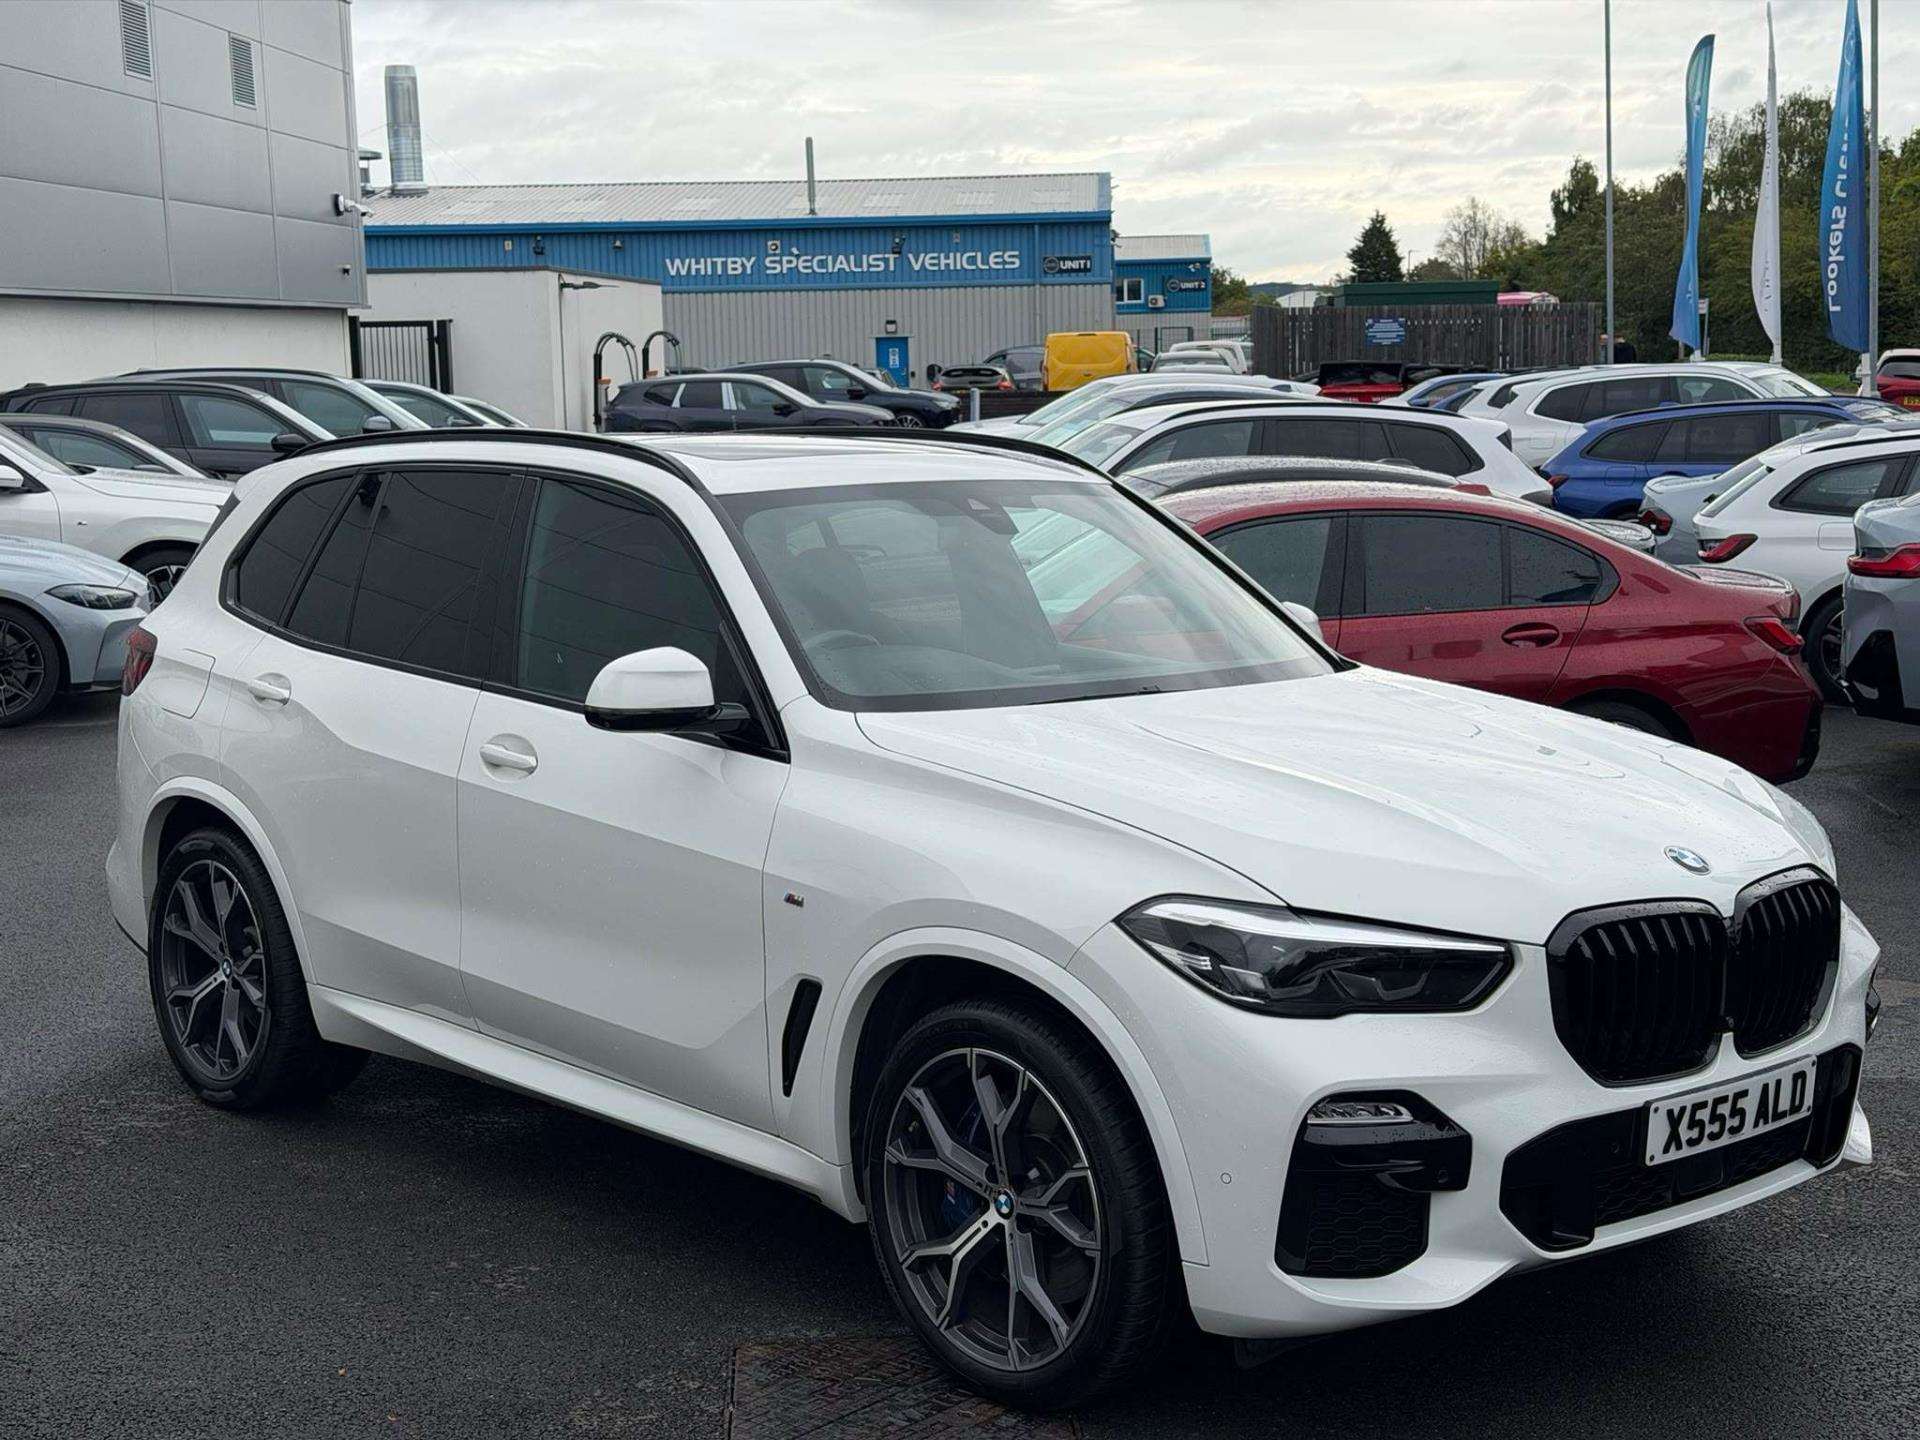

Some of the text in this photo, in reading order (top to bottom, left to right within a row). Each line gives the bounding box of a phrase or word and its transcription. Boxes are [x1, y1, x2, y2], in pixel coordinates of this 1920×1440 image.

[665, 251, 1021, 276] WHITBY SPECIALIST VEHICLES
[1060, 260, 1086, 269] UNIT
[1663, 1070, 1807, 1154] X555 ALD
